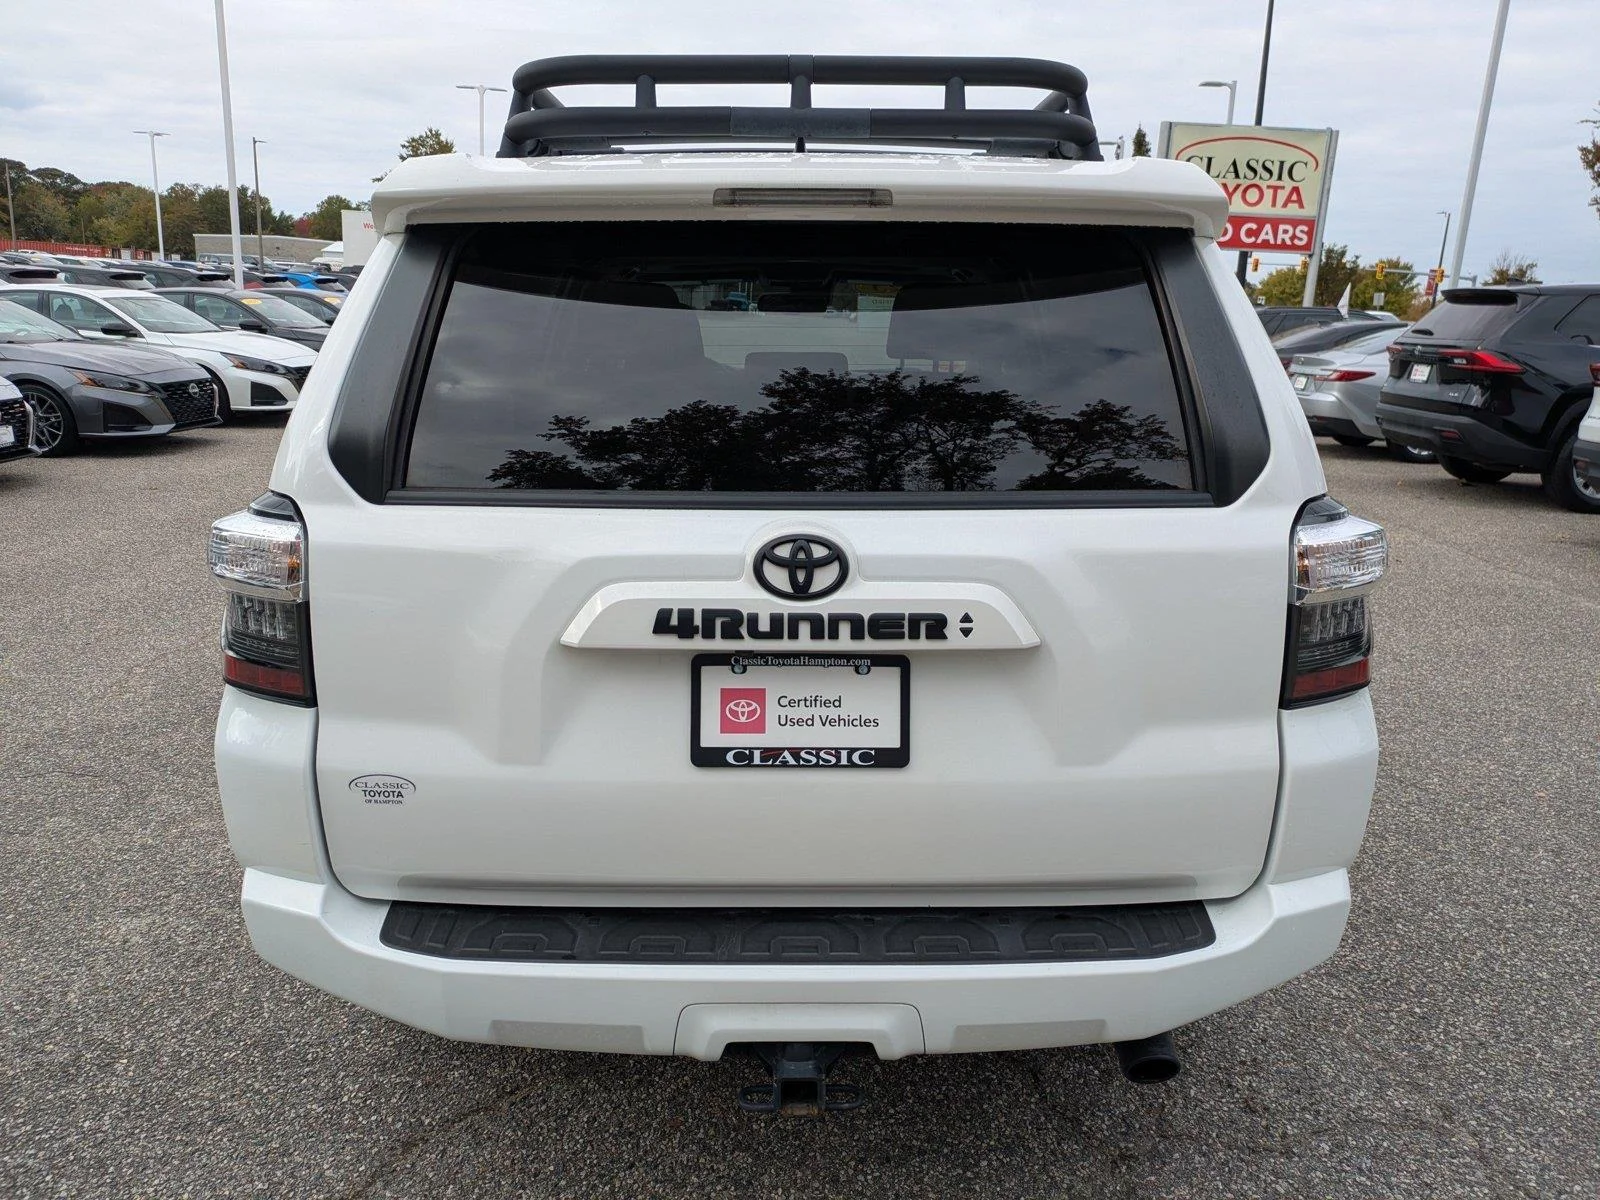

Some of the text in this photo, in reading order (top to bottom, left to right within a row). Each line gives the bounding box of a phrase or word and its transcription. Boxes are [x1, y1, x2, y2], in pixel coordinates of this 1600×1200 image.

[1221, 183, 1305, 209] YOTA
[1240, 223, 1309, 246] CARS
[652, 607, 949, 640] 4RUNNER
[731, 655, 871, 668] ClassicToyotaHampton.com
[777, 694, 842, 708] Certified
[777, 714, 879, 728] Used Vehicles
[725, 749, 875, 766] CLASSIC
[361, 789, 404, 798] TOYOTA
